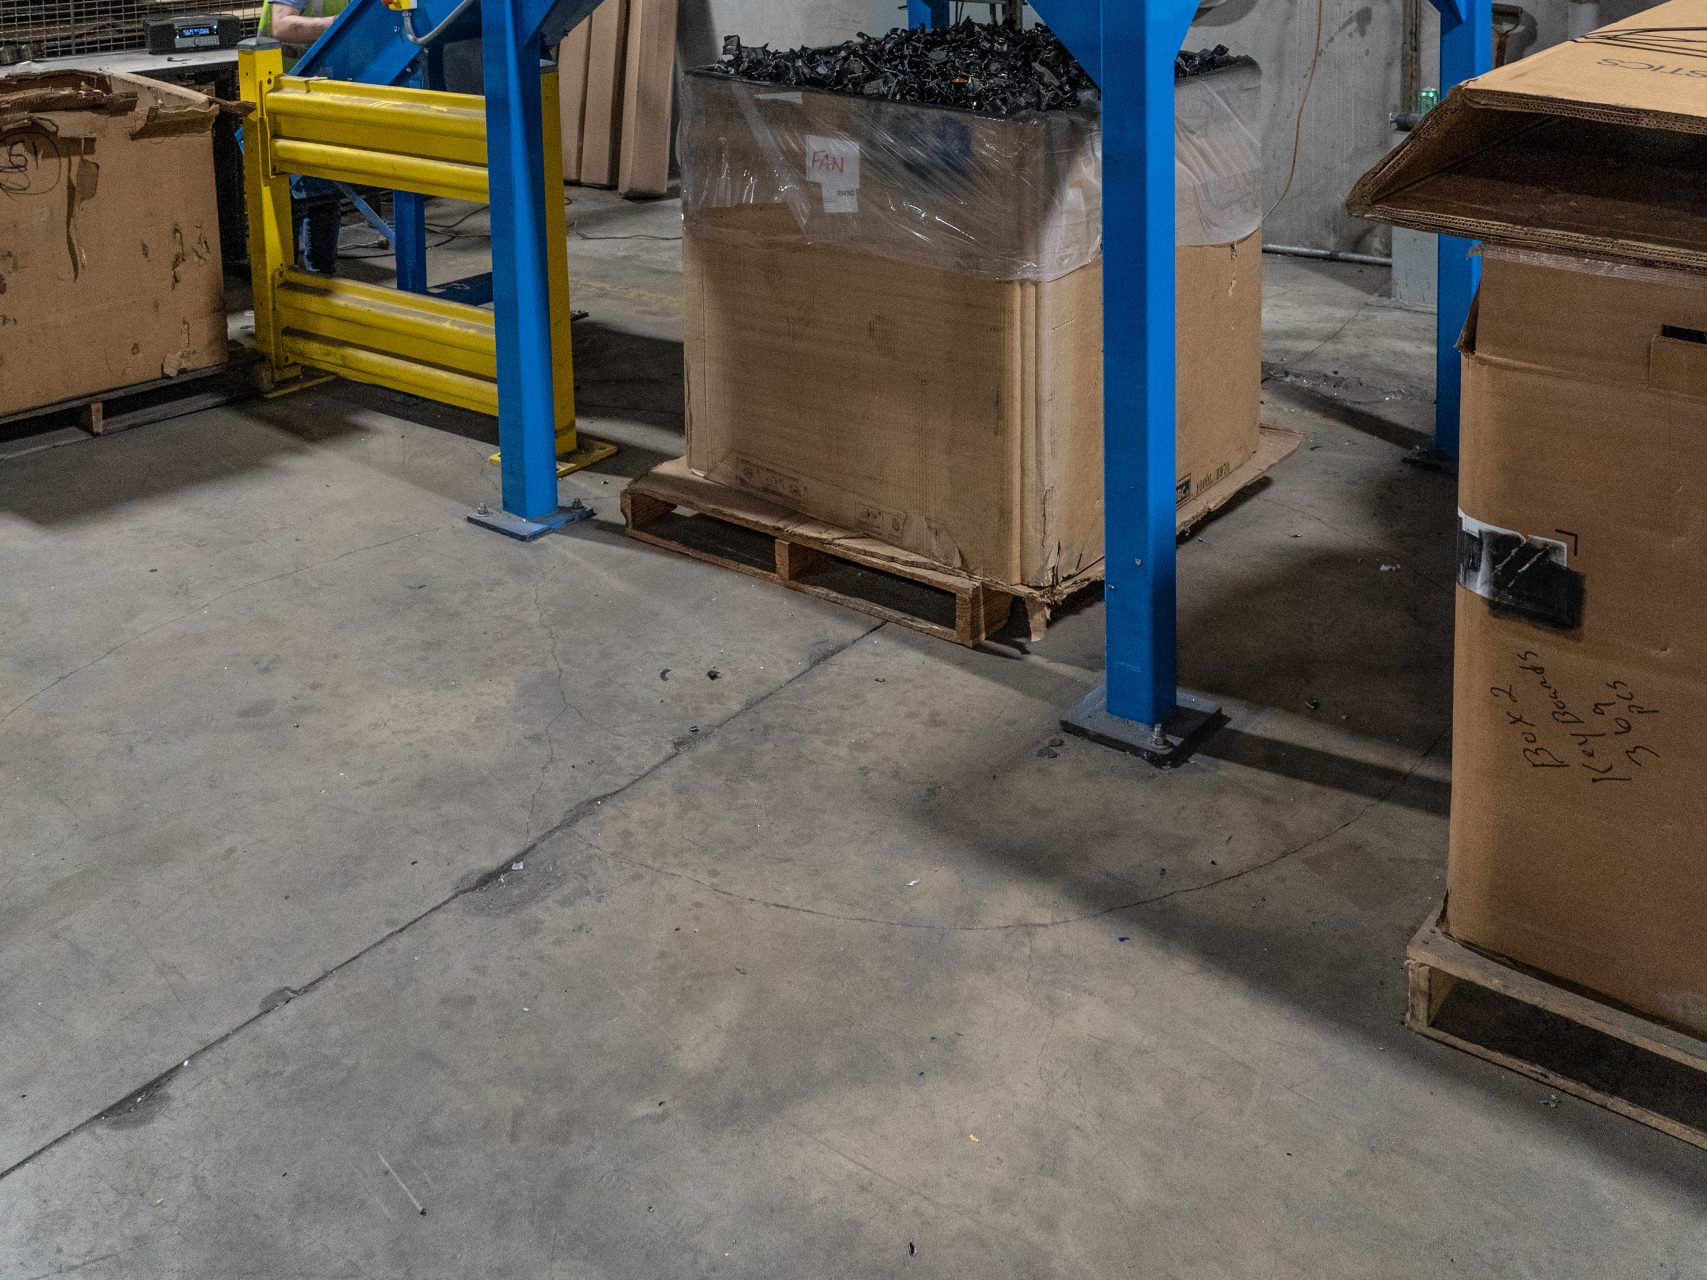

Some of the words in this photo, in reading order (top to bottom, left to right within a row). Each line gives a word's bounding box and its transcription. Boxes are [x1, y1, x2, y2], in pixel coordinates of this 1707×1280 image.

[812, 150, 844, 175] FAN
[1490, 685, 1518, 703] 2
[1507, 712, 1571, 767] Box
